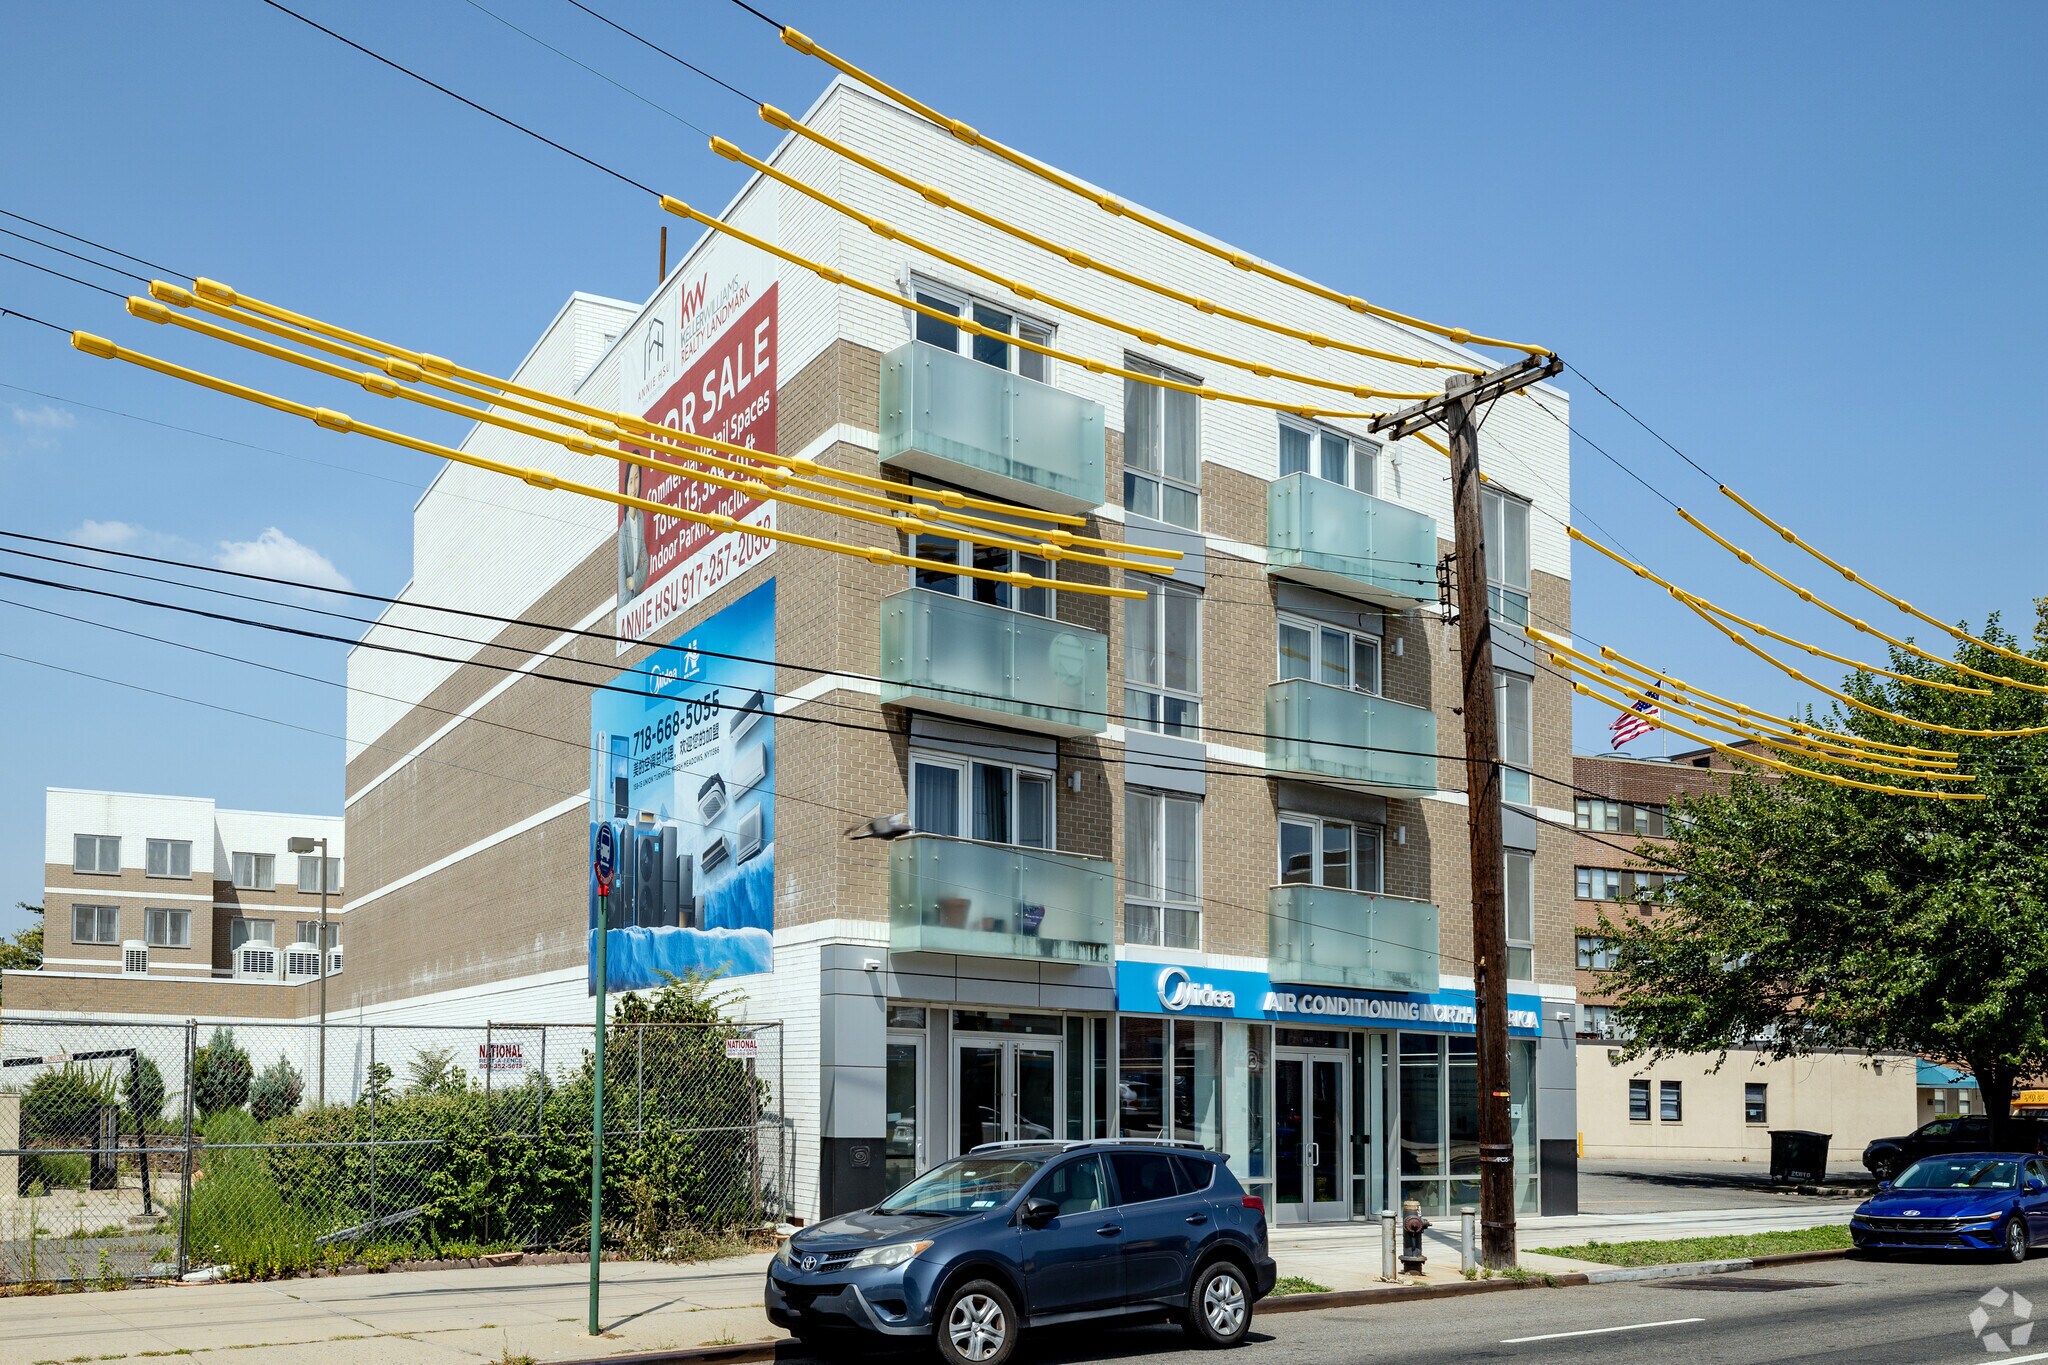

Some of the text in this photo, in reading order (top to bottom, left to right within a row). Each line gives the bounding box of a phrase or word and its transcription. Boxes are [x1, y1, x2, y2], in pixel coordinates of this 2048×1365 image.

[681, 280, 750, 367] REALTY LANDMARK
[637, 376, 656, 402] ANNIE
[658, 362, 671, 382] HSU
[702, 315, 771, 425] SALE
[731, 390, 770, 440] Spaces
[653, 491, 682, 540] Total
[619, 514, 771, 649] ANNIE HSU 917-257-2058
[649, 537, 678, 576] Indoor
[650, 664, 678, 695] Midea
[633, 688, 720, 757] 718-668-5055
[1157, 967, 1235, 1011] Midea
[1262, 991, 1298, 1012] AIR
[1298, 994, 1420, 1021] CONDITIONING
[1420, 1003, 1473, 1024] NORTH
[727, 1040, 758, 1049] NATIONAL
